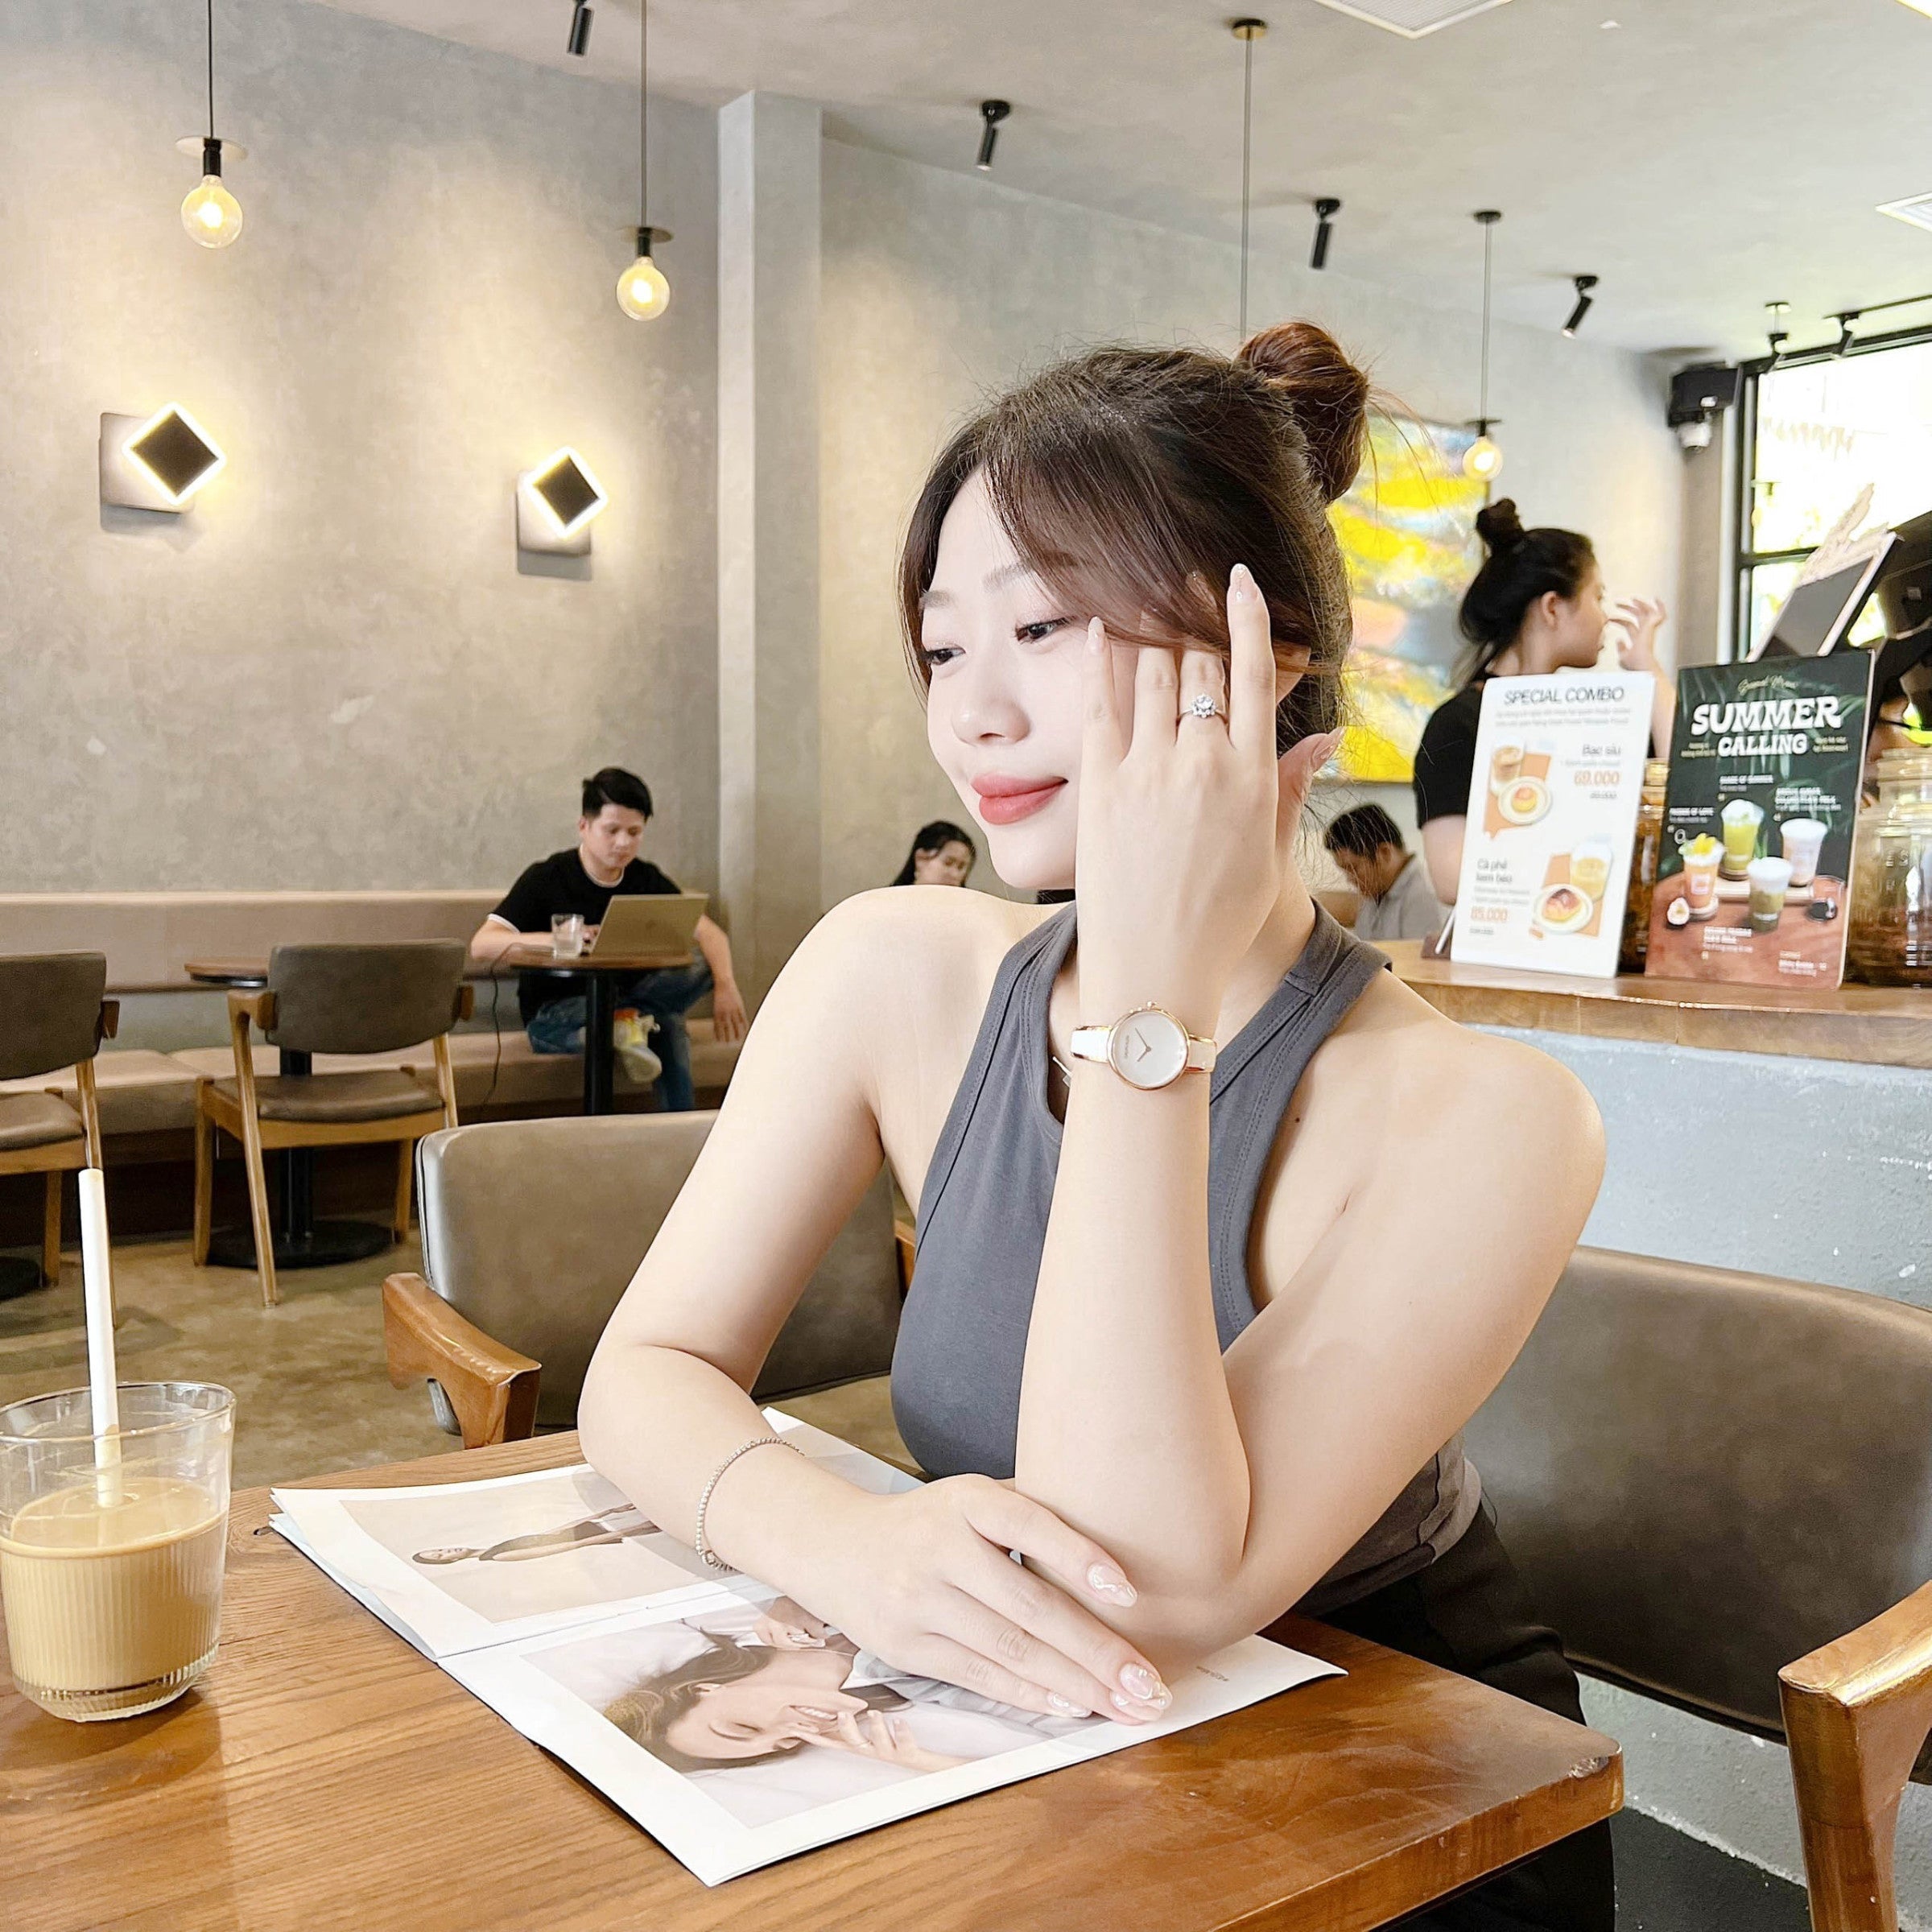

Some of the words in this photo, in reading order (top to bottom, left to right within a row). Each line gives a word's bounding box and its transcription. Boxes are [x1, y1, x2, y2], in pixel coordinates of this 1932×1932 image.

[1504, 688, 1561, 705] SPECIAL
[1565, 687, 1624, 704] COMBO
[1691, 696, 1841, 735] SUMMER
[1717, 733, 1809, 757] CALLING
